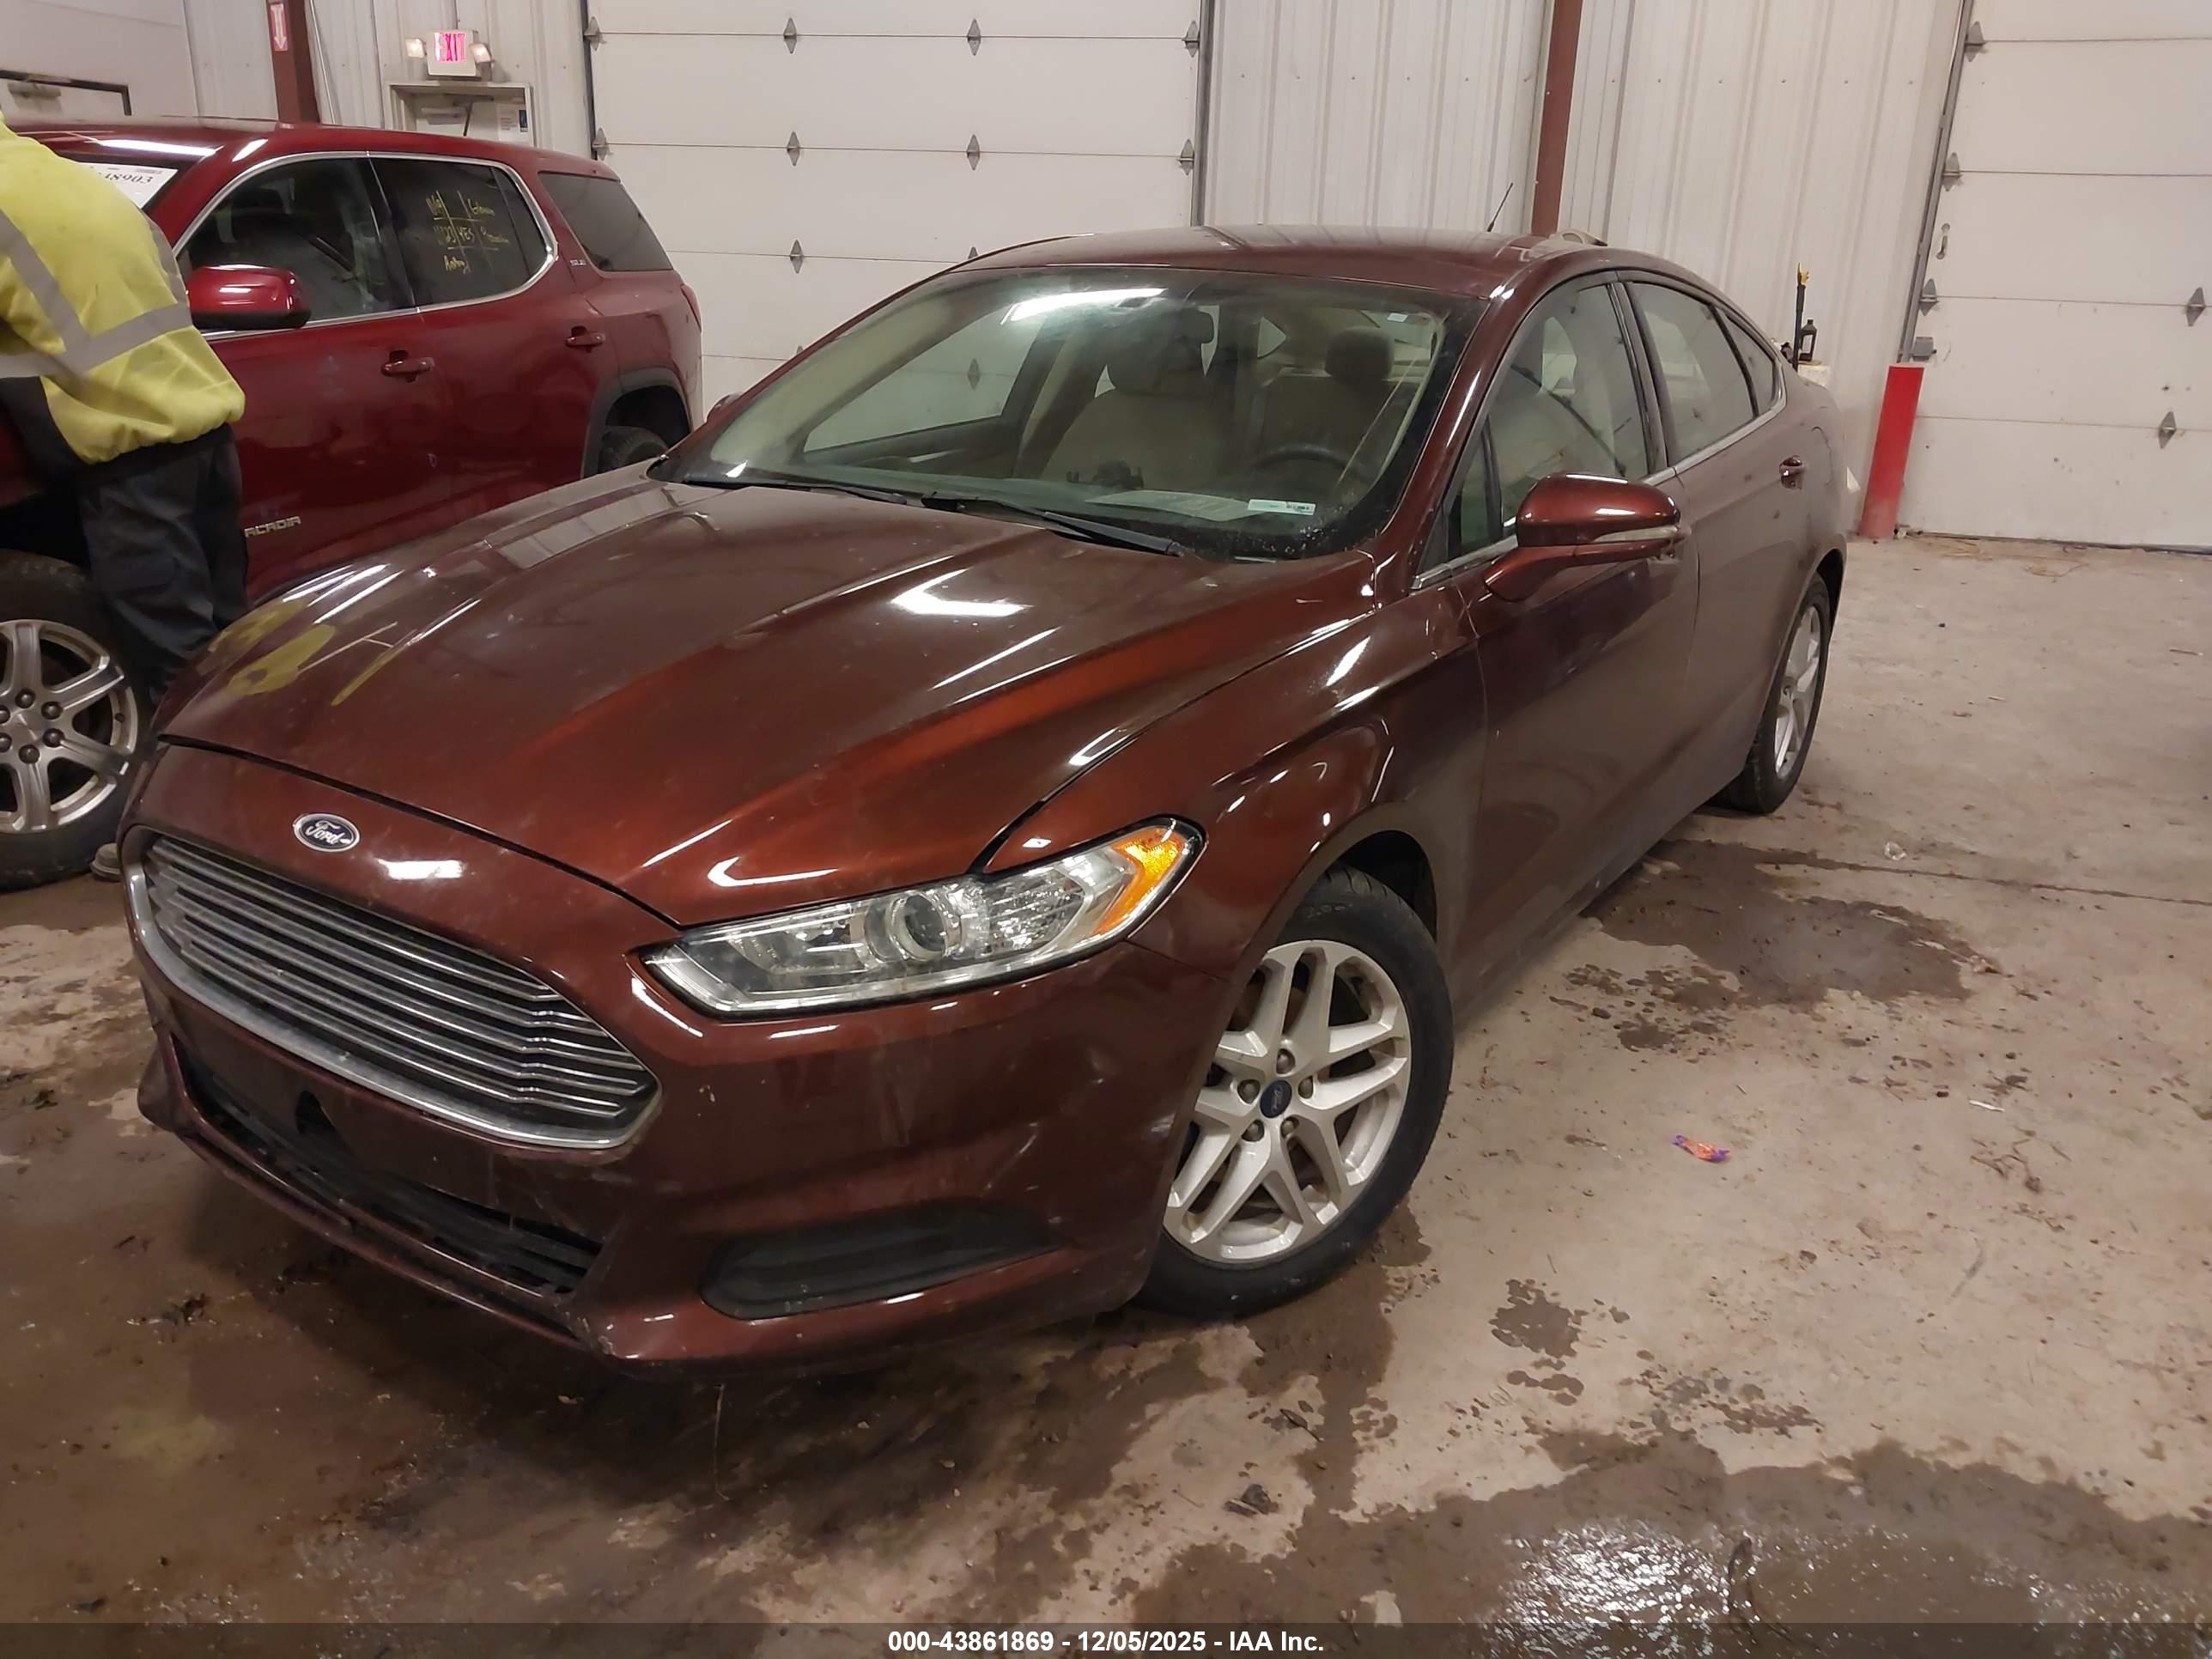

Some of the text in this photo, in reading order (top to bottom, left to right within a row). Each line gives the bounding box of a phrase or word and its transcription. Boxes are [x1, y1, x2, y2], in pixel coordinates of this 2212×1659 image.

[434, 32, 466, 63] EXIT
[244, 515, 301, 538] ACADIA
[305, 820, 345, 845] Ford
